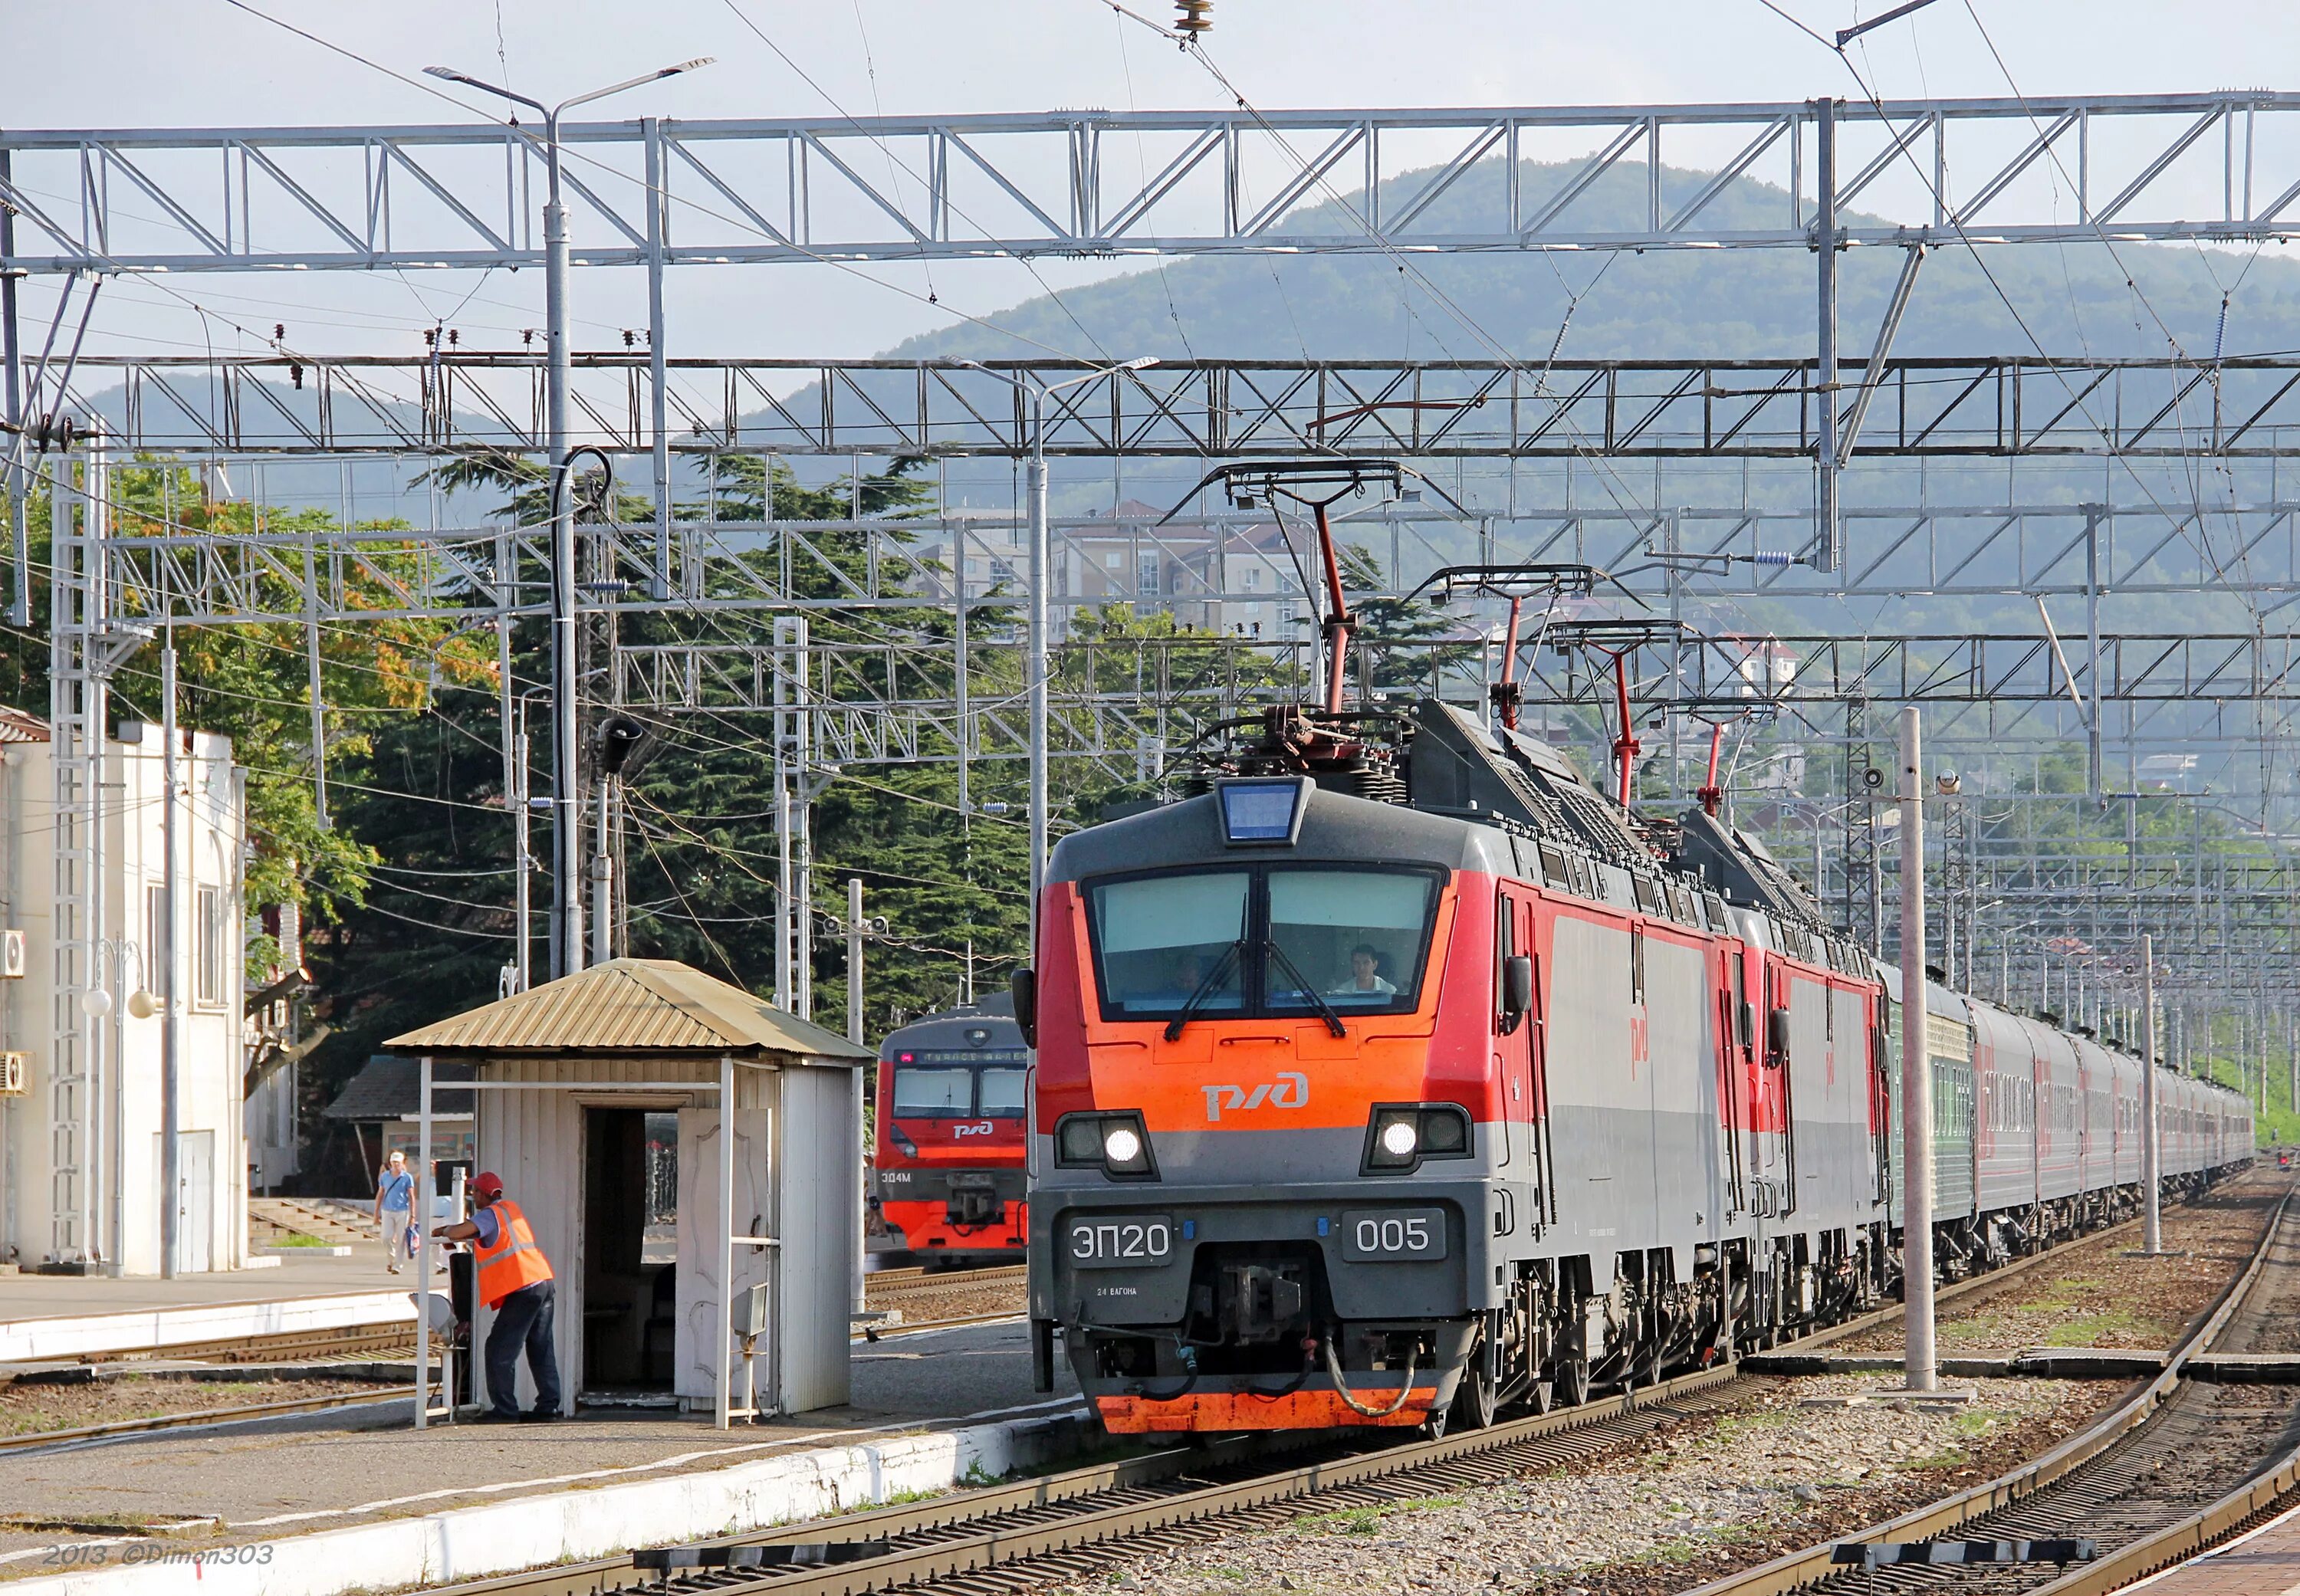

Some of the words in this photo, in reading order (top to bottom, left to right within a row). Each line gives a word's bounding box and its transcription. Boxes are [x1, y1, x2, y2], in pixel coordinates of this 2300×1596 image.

[881, 1172, 911, 1183] ЭД4М
[1072, 1223, 1170, 1259] ЭП20
[1355, 1218, 1430, 1253] 005
